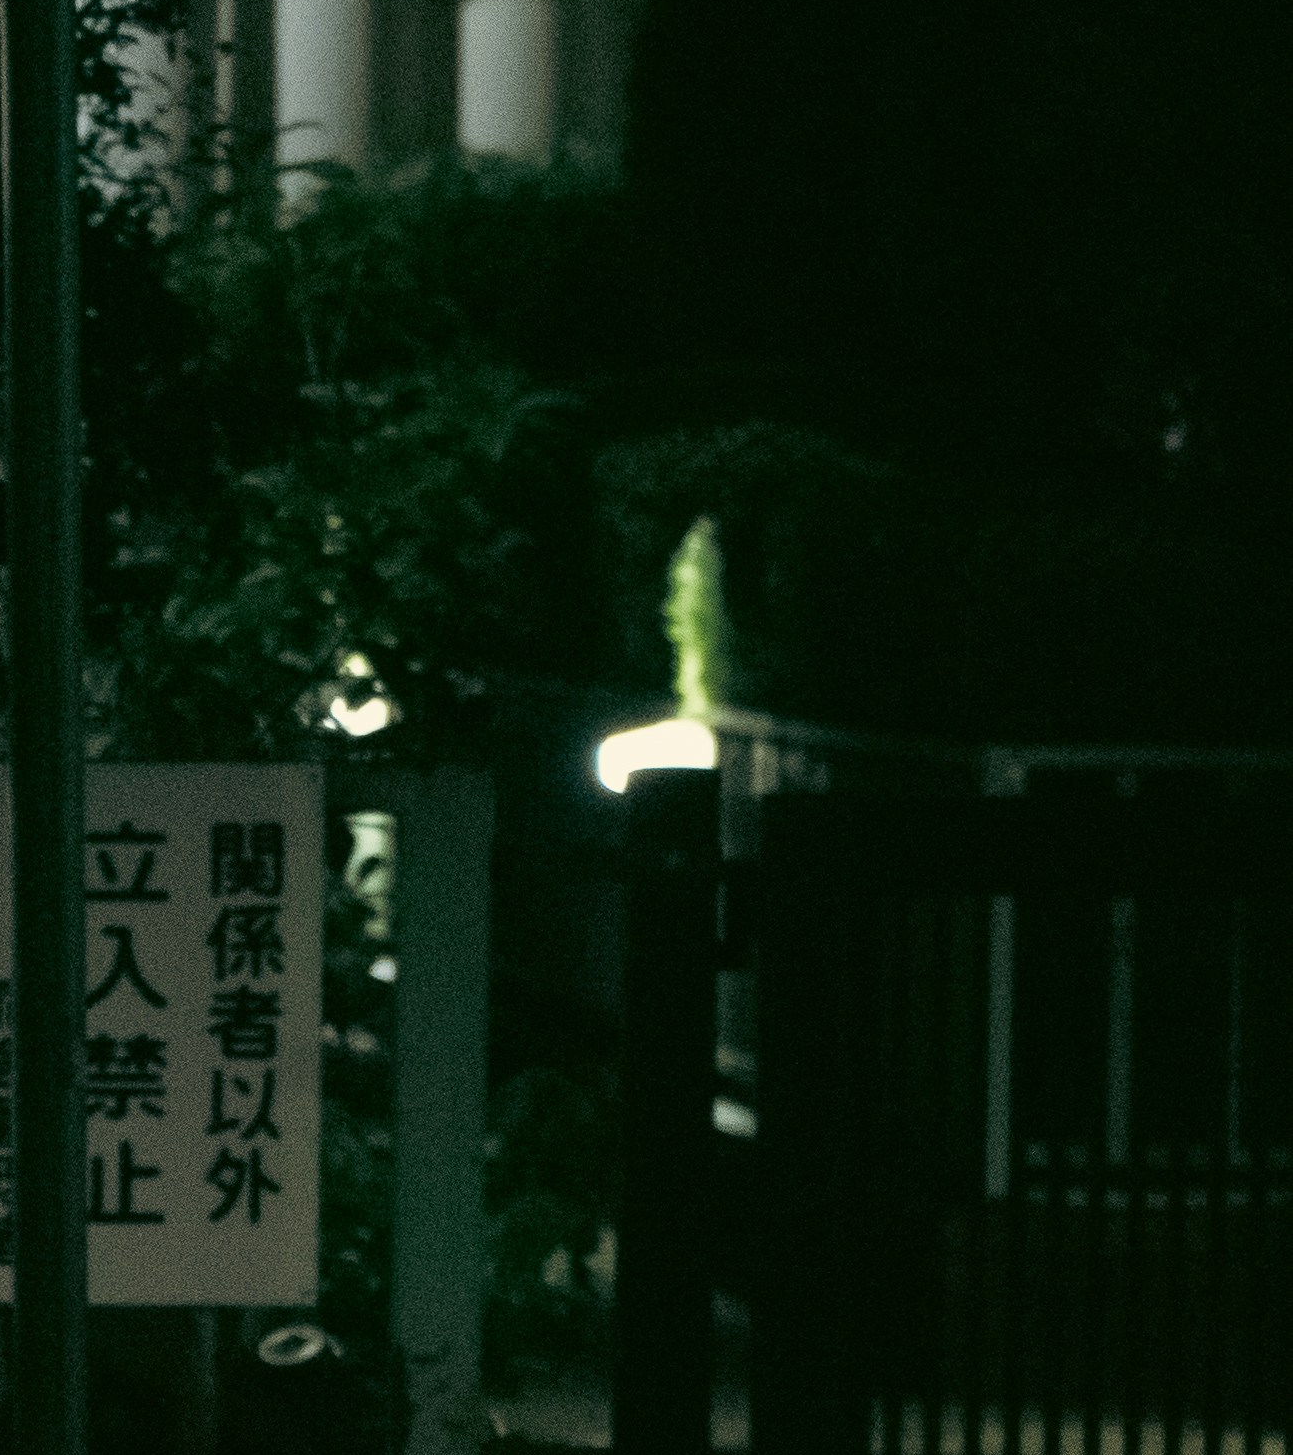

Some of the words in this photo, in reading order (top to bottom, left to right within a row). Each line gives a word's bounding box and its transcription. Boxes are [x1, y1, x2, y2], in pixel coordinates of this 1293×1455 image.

[86, 820, 169, 1225] 立入禁止
[207, 822, 286, 1225] 関係者以外
